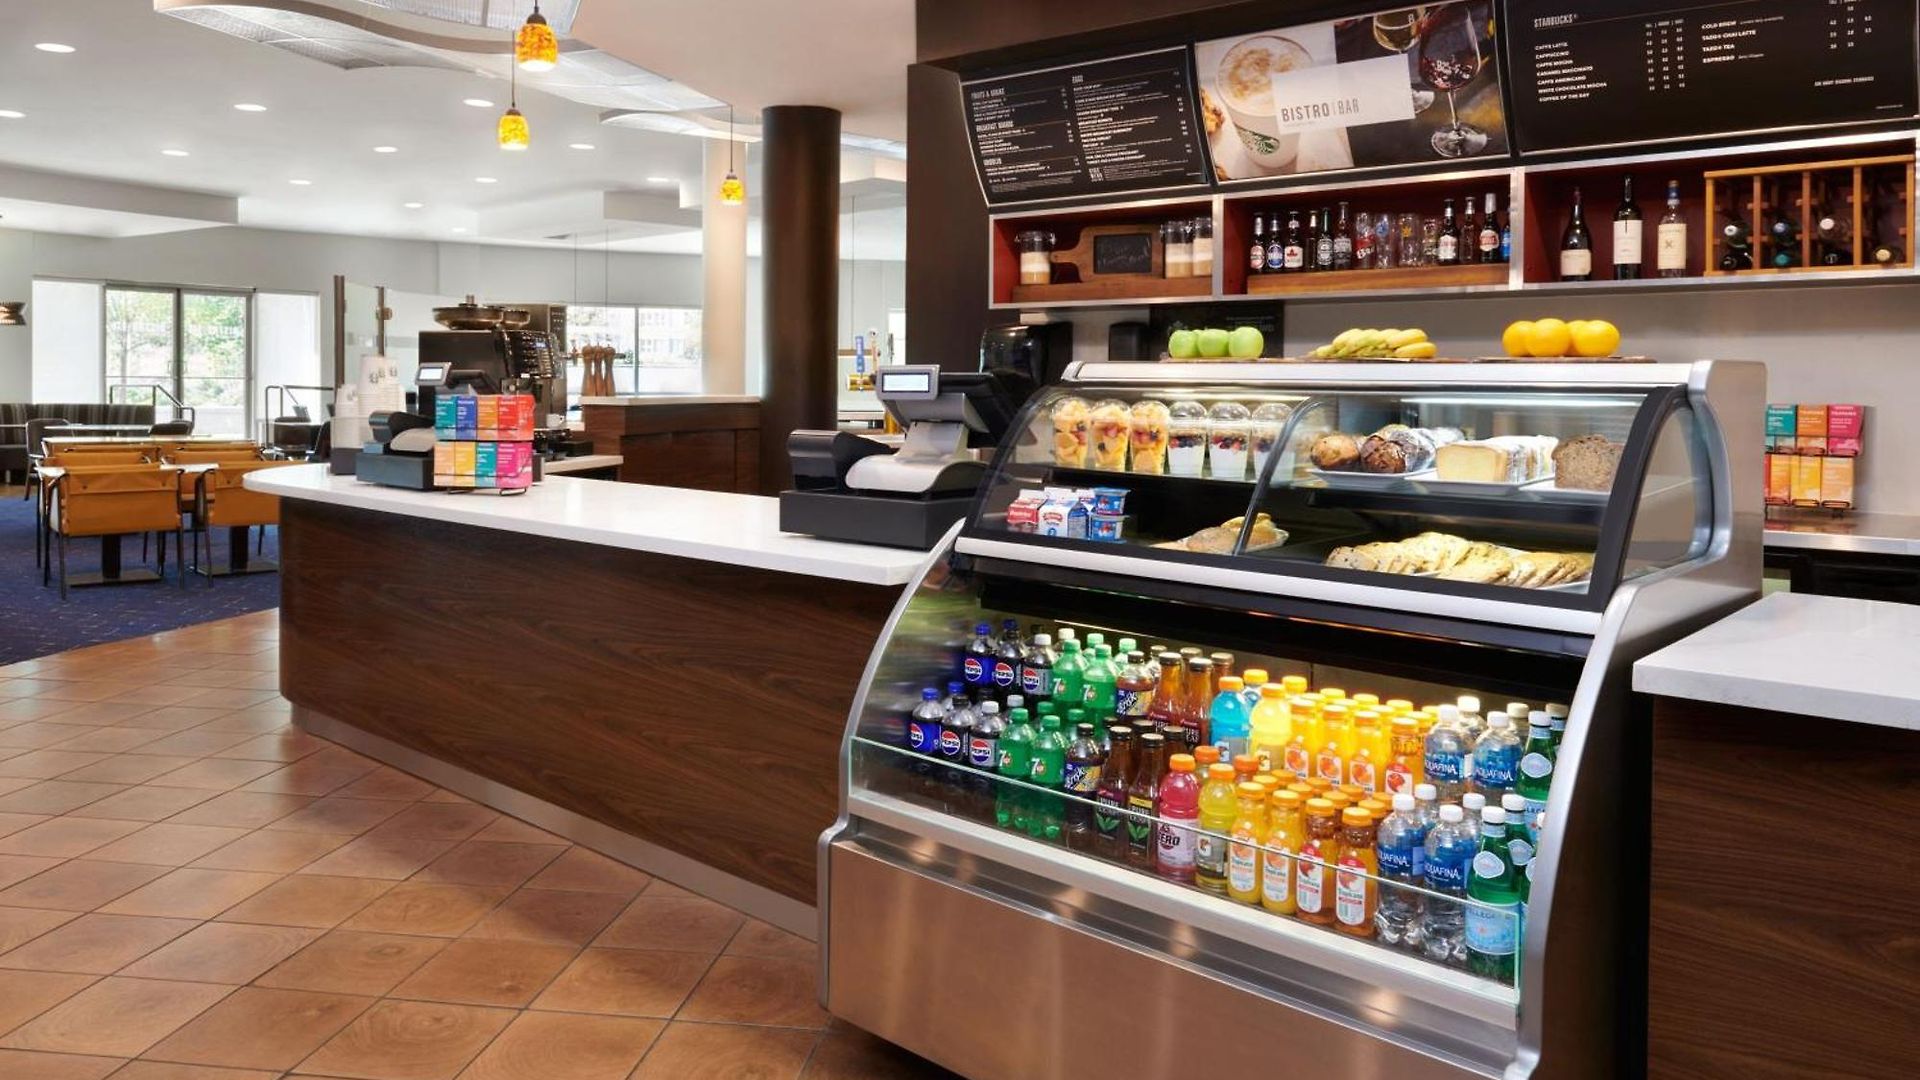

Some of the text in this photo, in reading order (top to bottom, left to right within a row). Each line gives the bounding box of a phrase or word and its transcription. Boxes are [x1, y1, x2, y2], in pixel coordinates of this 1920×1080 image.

[1281, 98, 1360, 122] BISTRO BAR
[1159, 833, 1181, 846] ERO
